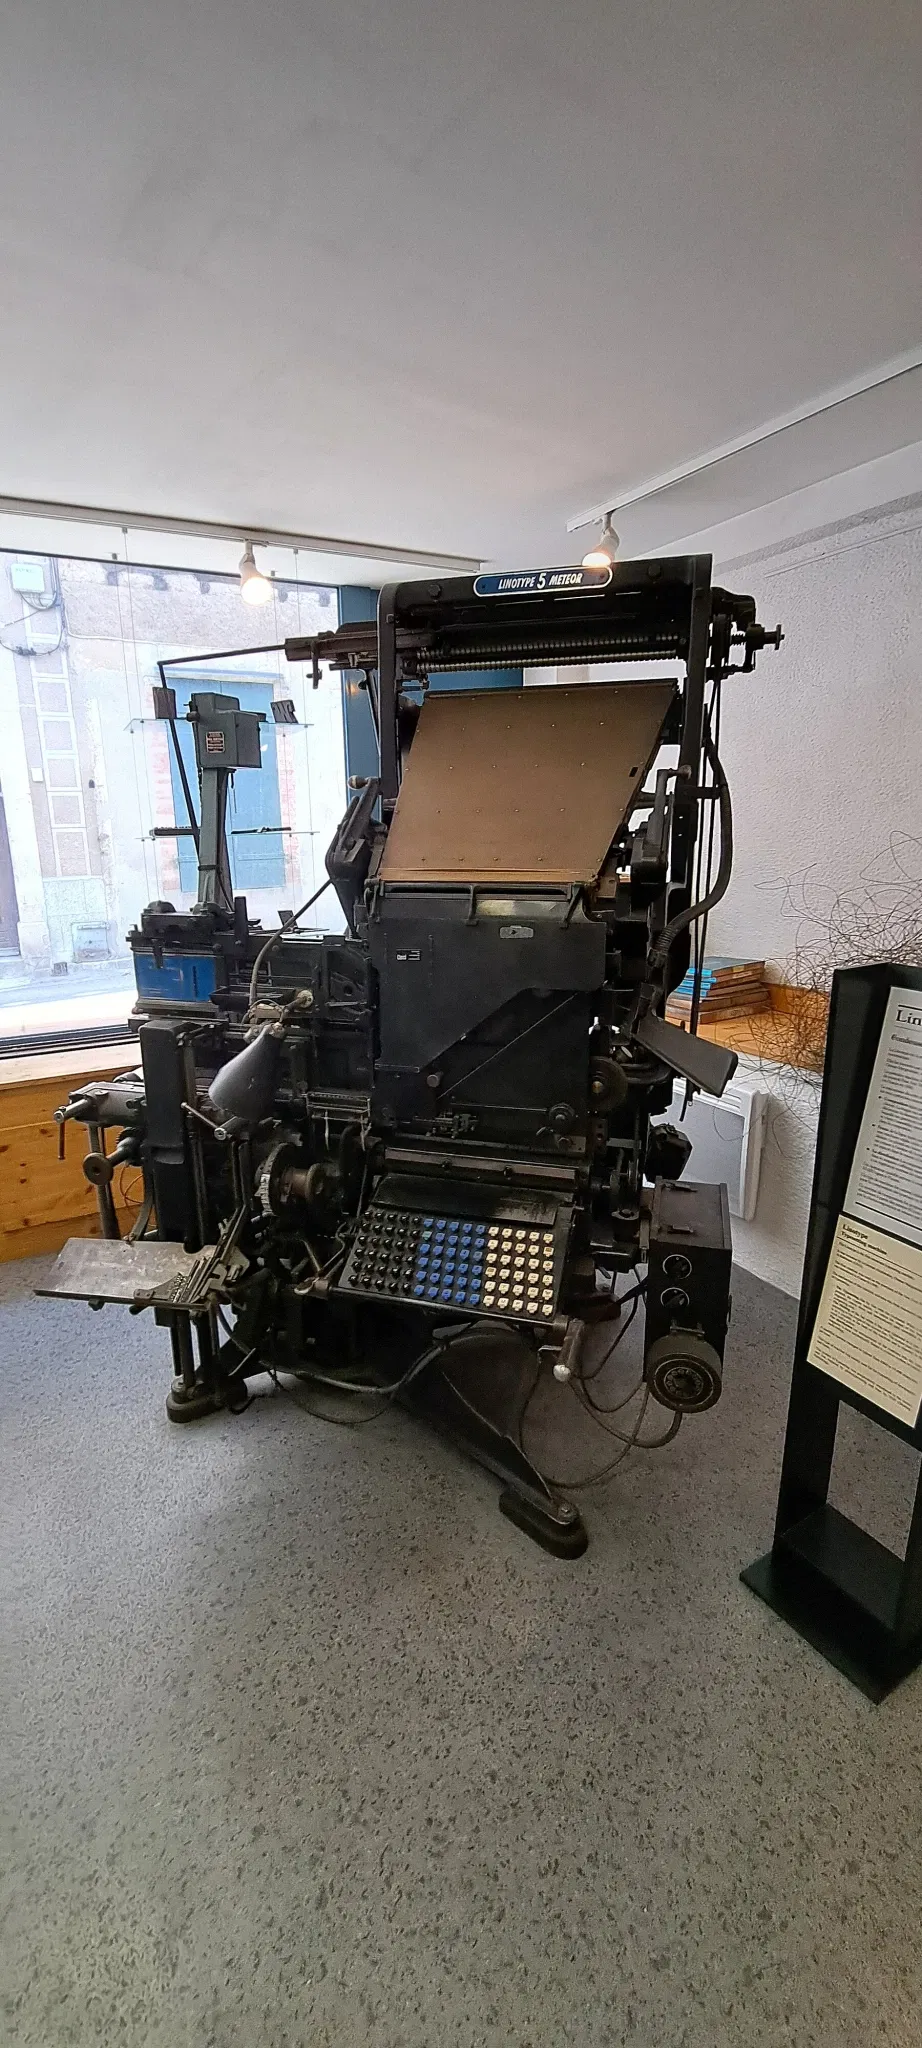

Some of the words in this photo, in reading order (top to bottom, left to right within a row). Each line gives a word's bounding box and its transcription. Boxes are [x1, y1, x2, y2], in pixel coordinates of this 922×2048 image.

[498, 576, 536, 590] LINOTYPE
[536, 572, 547, 589] 5
[548, 573, 583, 586] METEOR
